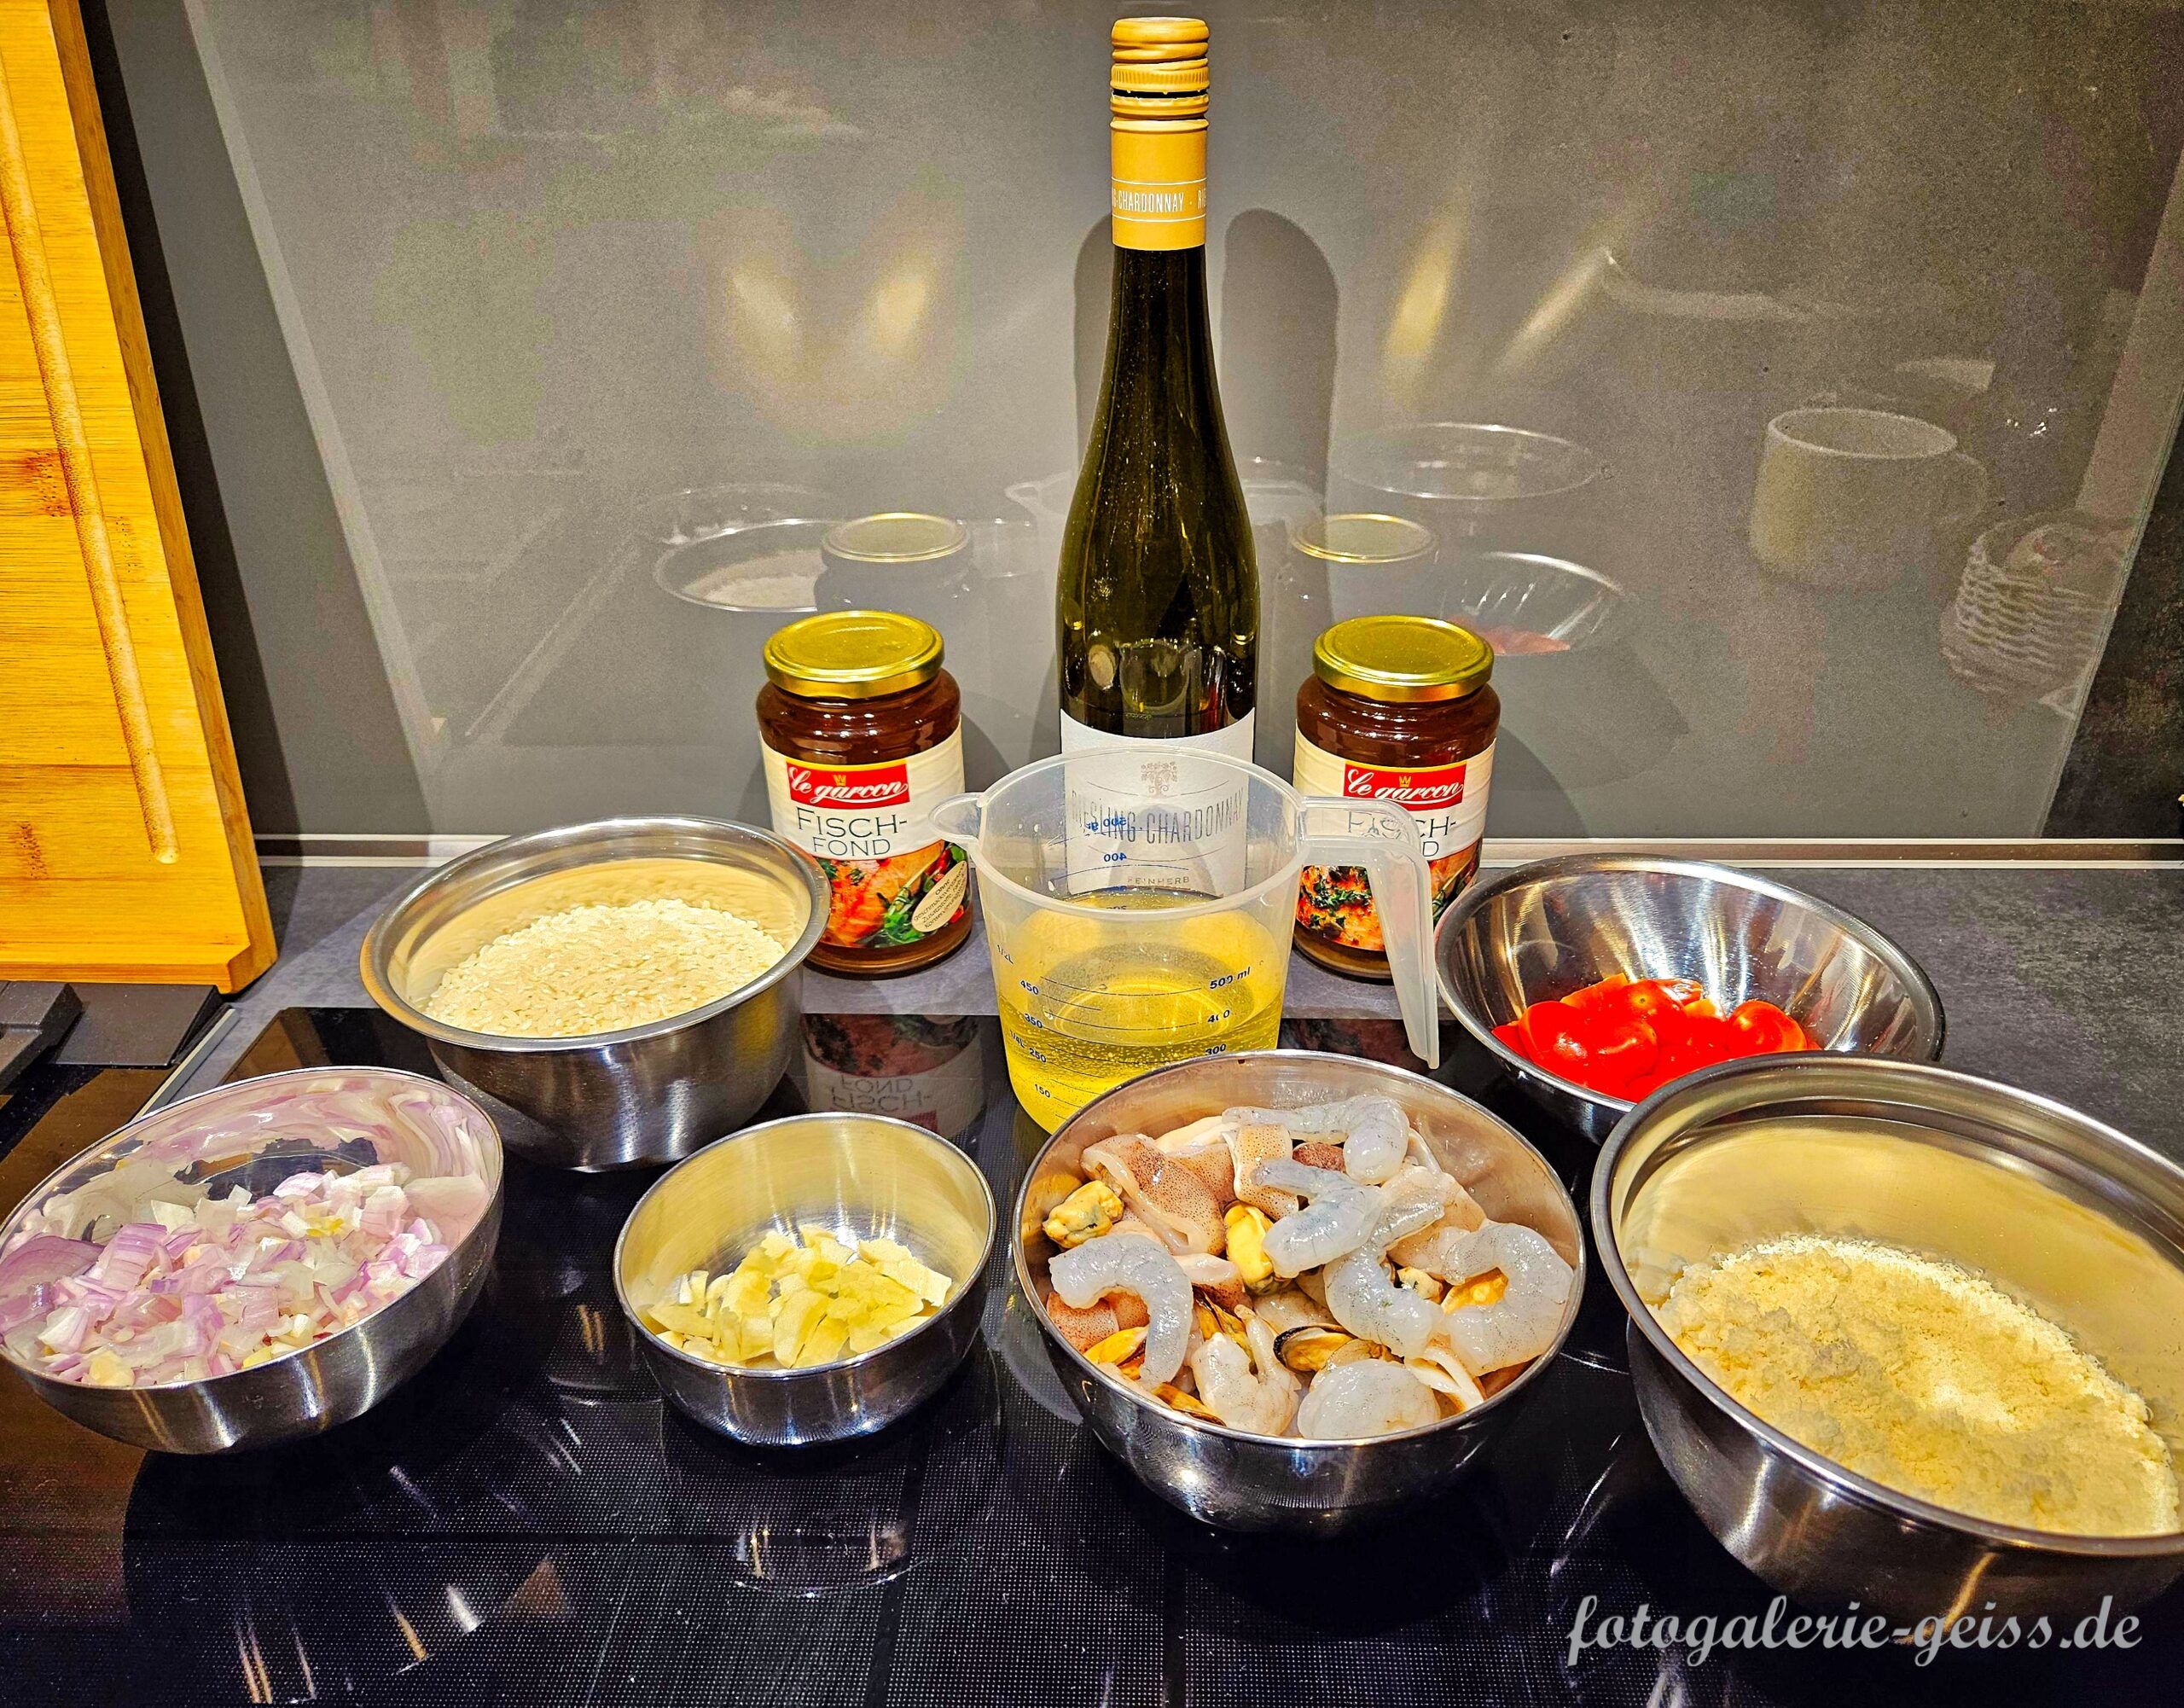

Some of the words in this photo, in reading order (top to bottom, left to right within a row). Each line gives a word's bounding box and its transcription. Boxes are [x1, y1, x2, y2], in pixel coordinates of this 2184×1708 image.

[796, 806, 908, 838] FISCH-
[812, 836, 891, 857] FOND
[1210, 975, 1234, 990] 500
[1237, 966, 1251, 979] ml
[1020, 980, 1040, 996] 450
[1025, 1014, 1044, 1029] 350
[1029, 1048, 1047, 1063] 250
[1205, 1043, 1227, 1056] 300
[1034, 1083, 1051, 1098] 150
